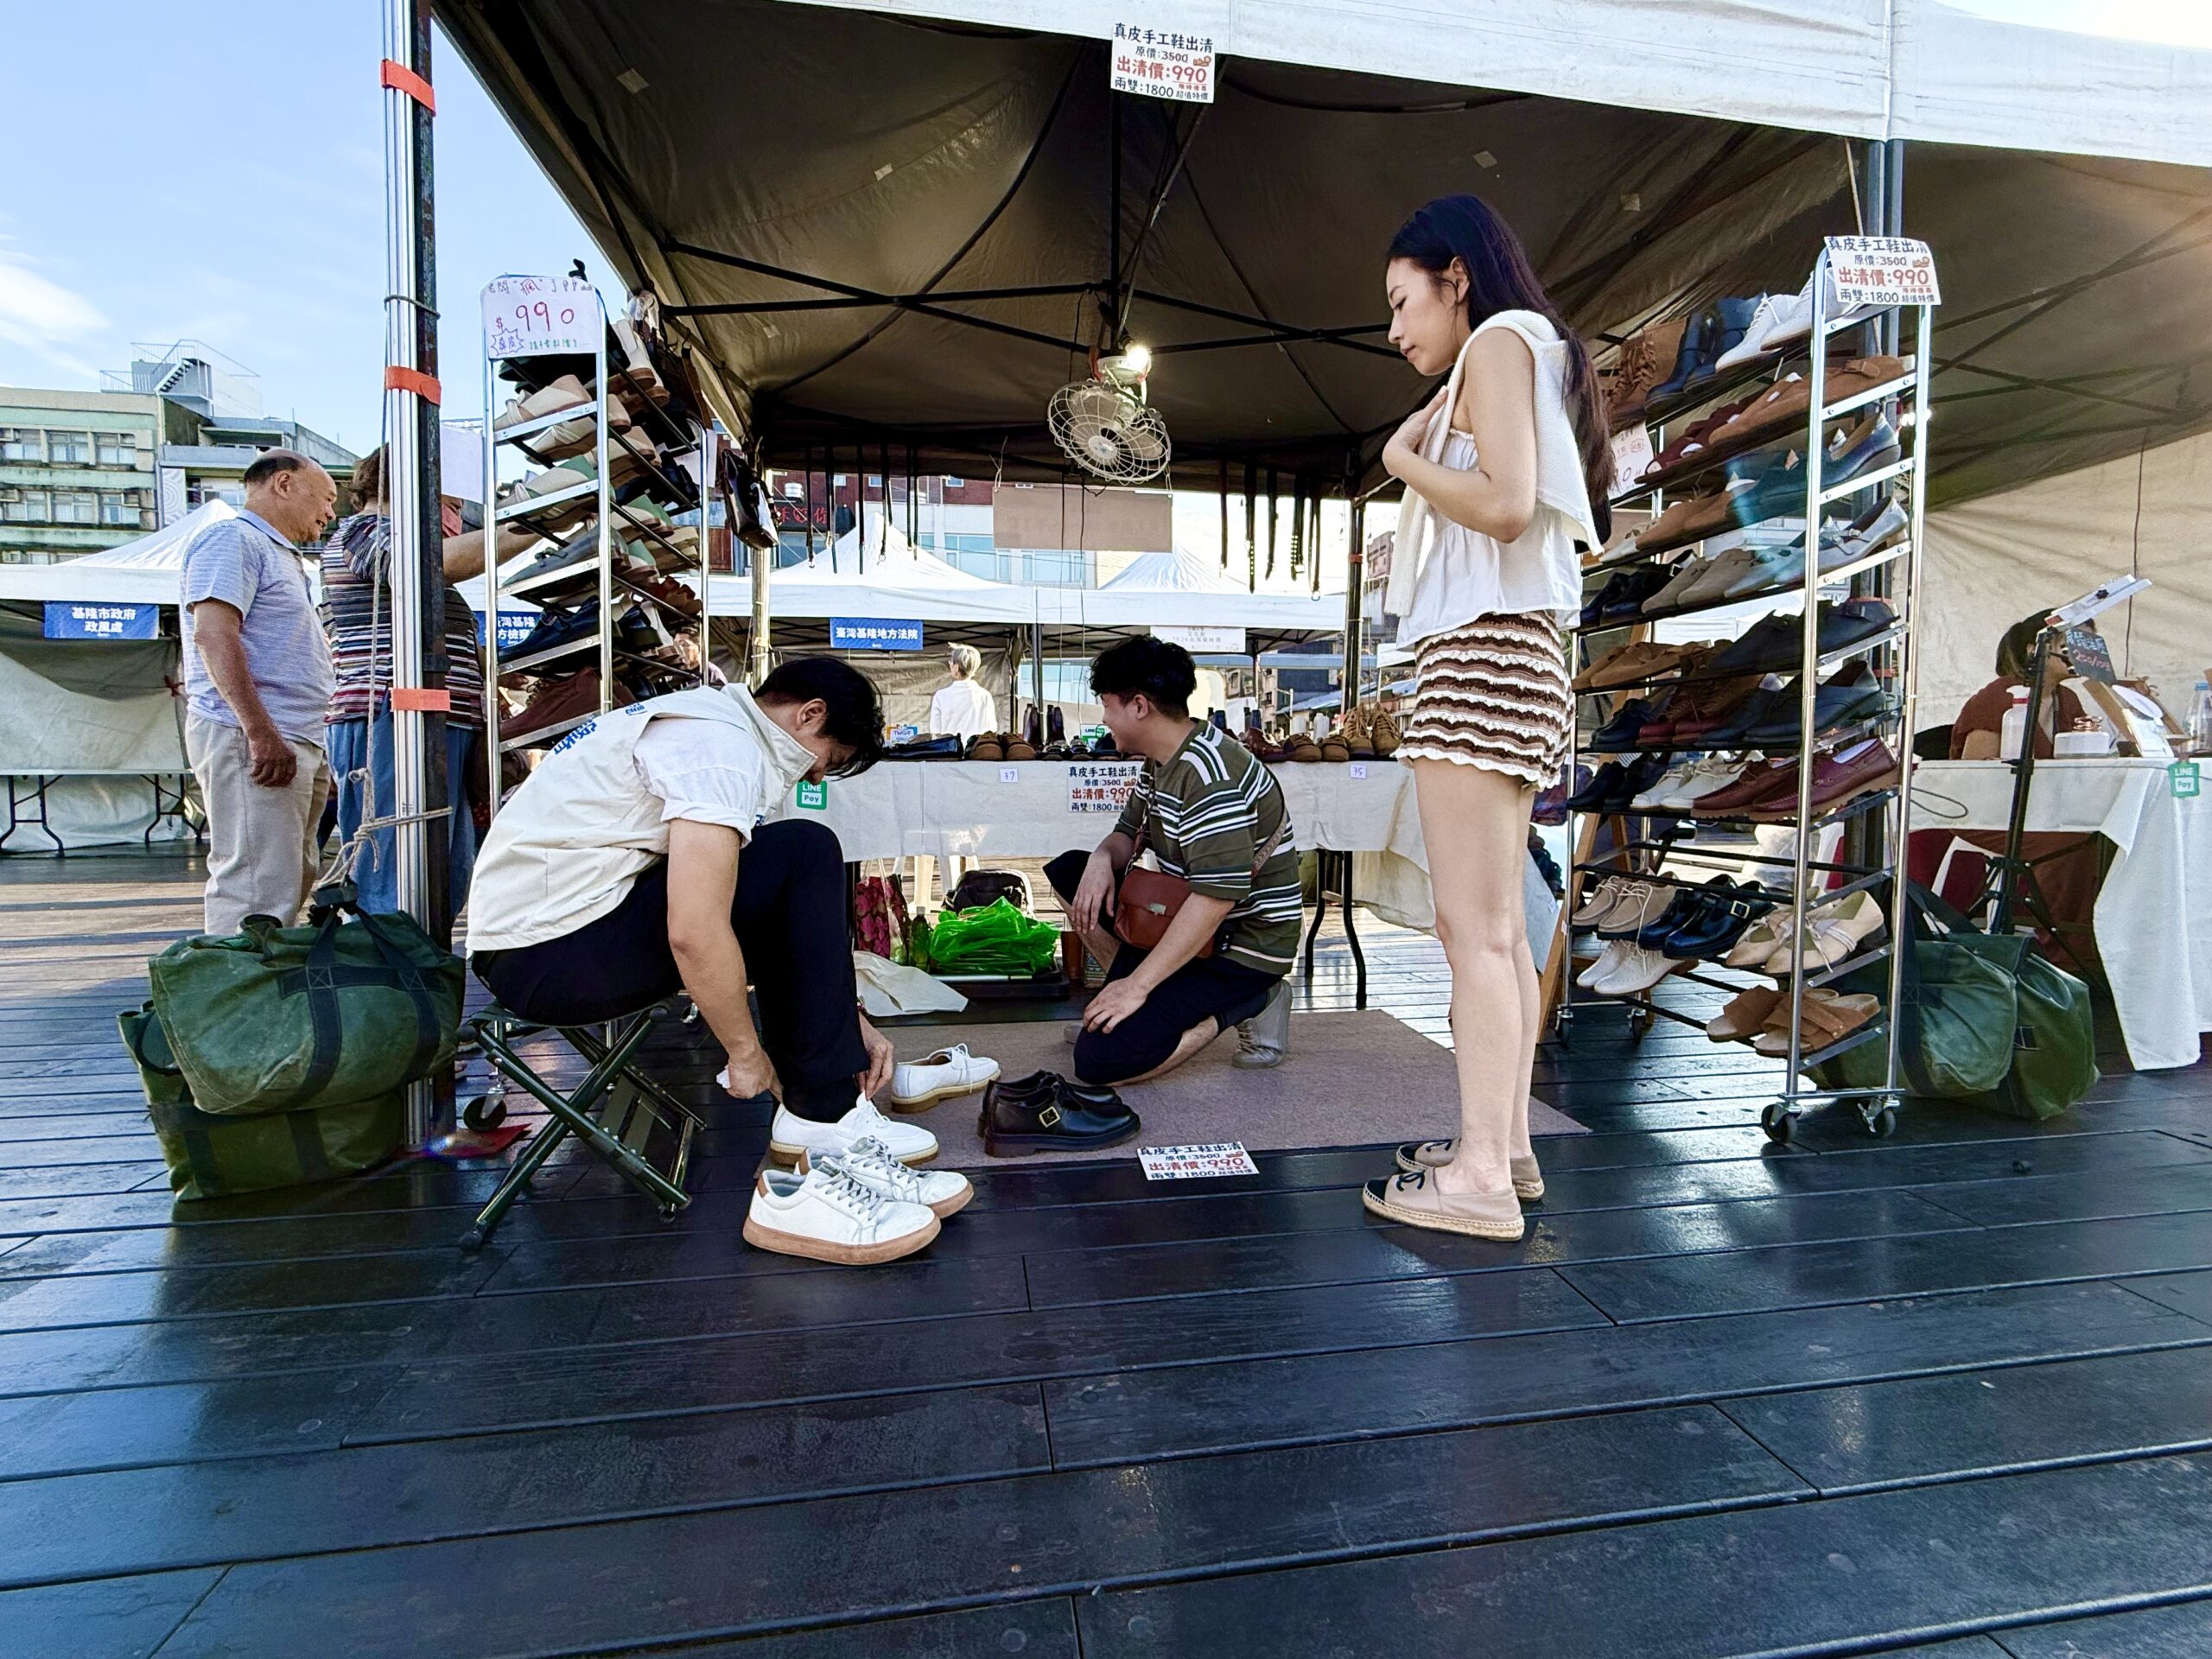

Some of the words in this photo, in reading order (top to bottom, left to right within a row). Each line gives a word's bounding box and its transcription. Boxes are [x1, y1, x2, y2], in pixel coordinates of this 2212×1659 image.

[1114, 22, 1213, 54] 真皮手工鞋出清
[1116, 55, 1207, 83] 出清價:990
[1115, 76, 1174, 98] 兩雙:1800
[1827, 235, 1928, 253] 真皮手工鞋出清
[1839, 267, 1929, 287] 出清價:990
[1840, 289, 1899, 302] 兩雙:1800
[516, 302, 575, 332] 990
[72, 607, 136, 620] 基隆市政府
[85, 621, 123, 632] 政風處
[836, 627, 918, 639] 臺灣基隆地方法院
[1069, 766, 1137, 778] 真皮手工鞋出清
[2174, 767, 2194, 776] LINE
[1141, 1142, 1242, 1155] 真皮手工鞋出清
[1148, 1158, 1244, 1171] 出清價:990
